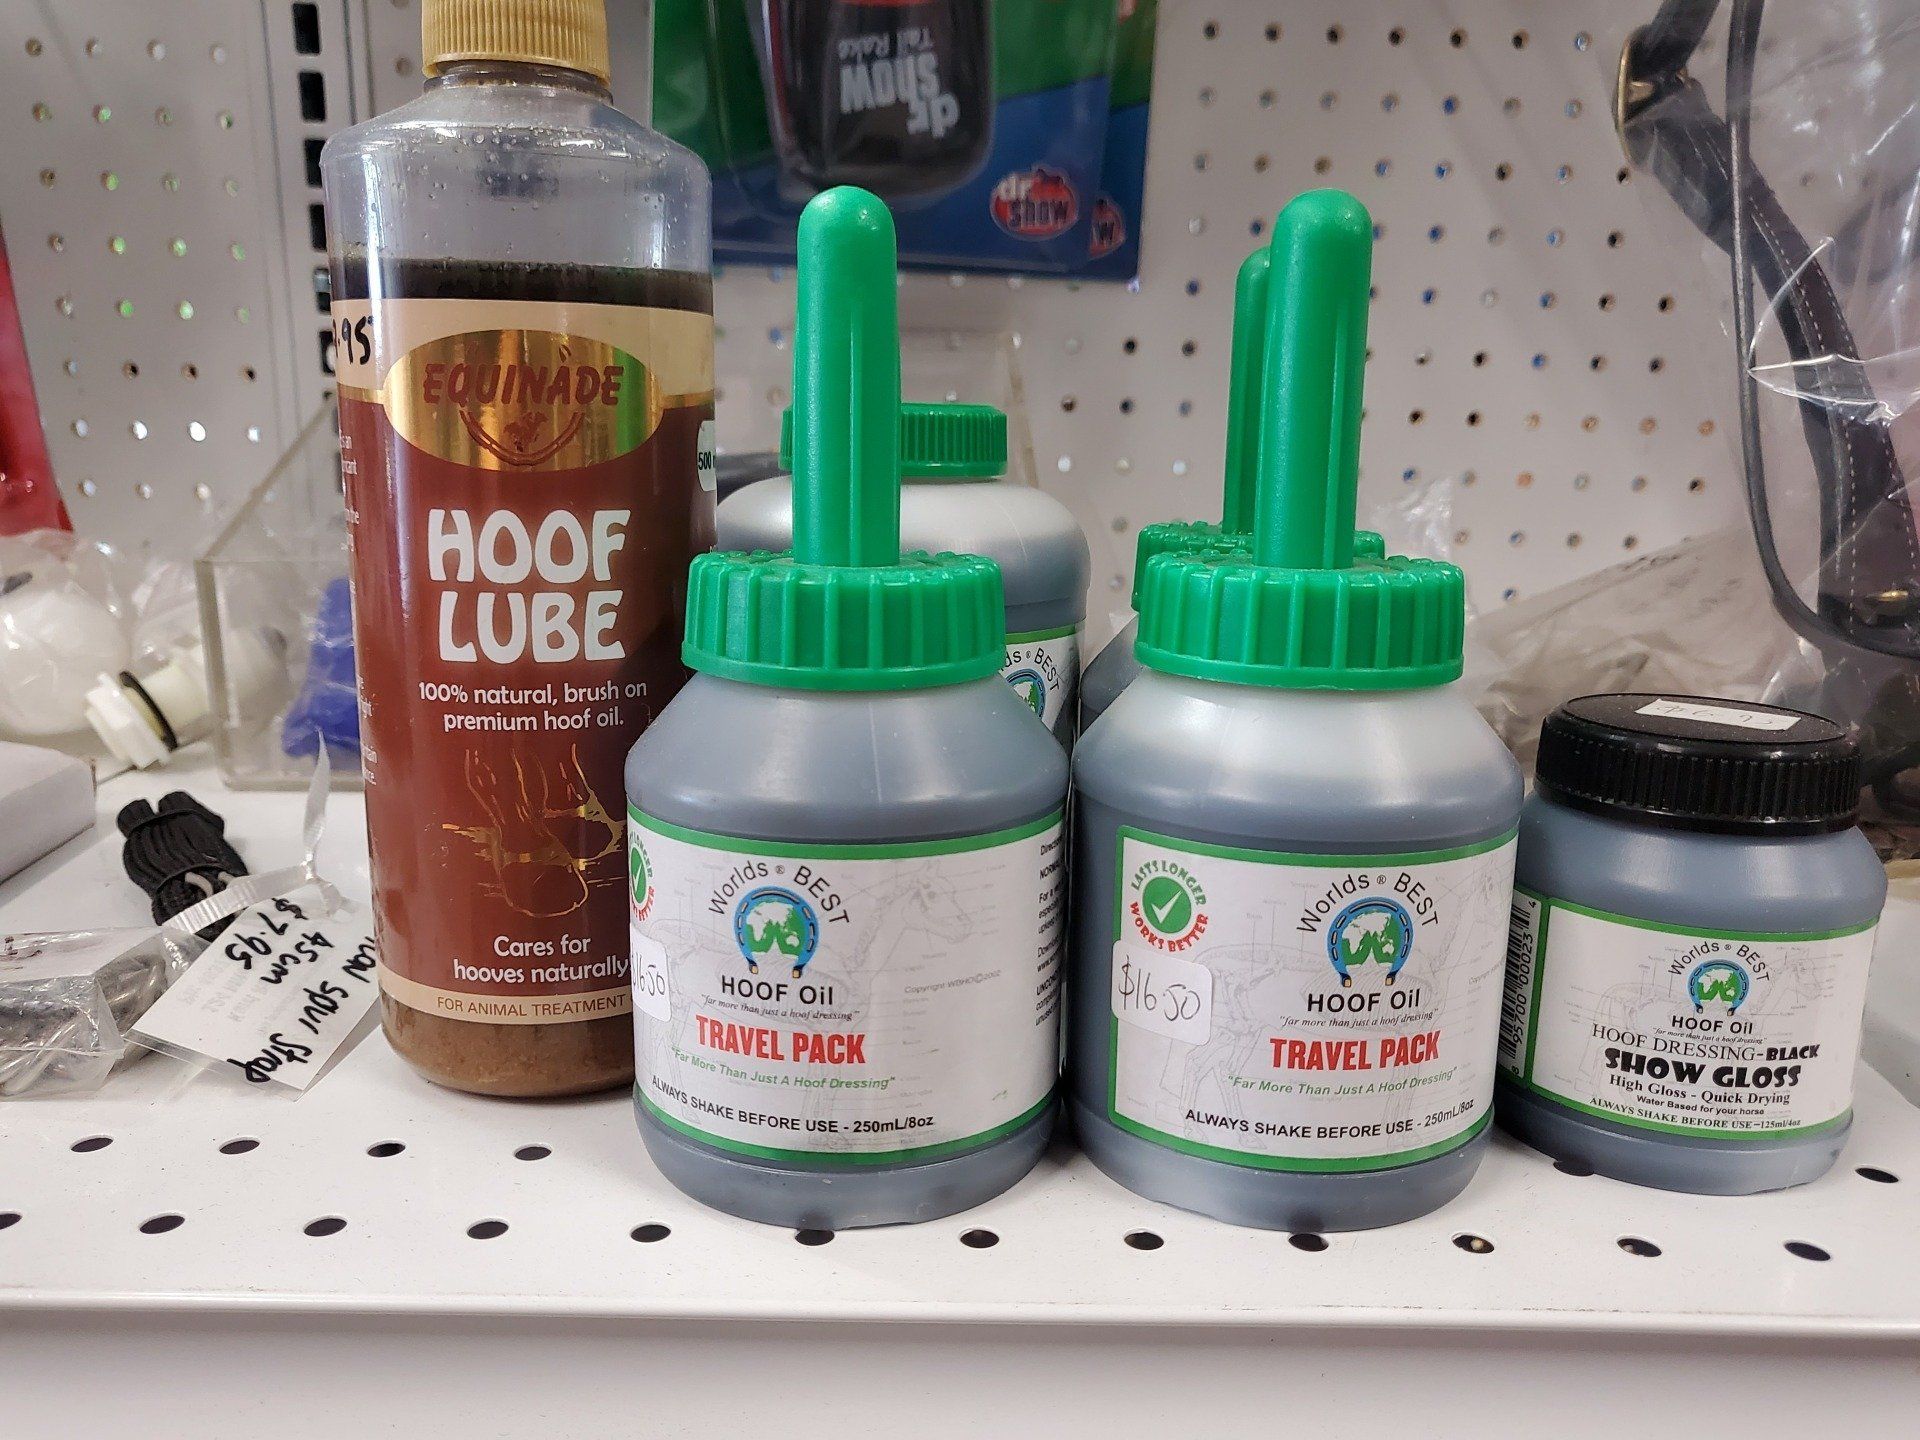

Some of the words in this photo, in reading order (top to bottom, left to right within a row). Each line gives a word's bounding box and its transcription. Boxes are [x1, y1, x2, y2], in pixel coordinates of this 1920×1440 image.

[698, 451, 711, 470] 500
[428, 509, 631, 584] HOOF
[439, 590, 626, 664] LUBE
[1034, 647, 1059, 690] BEST
[419, 682, 468, 703] 100%
[474, 683, 558, 705] natural,
[564, 681, 619, 703] brush
[625, 681, 647, 698] on
[444, 711, 537, 732] premium
[544, 709, 591, 730] hoof
[597, 706, 624, 727] oil.
[709, 860, 768, 915] Worlds
[793, 865, 849, 923] BEST
[1131, 860, 1158, 891] LASTS
[1161, 860, 1207, 906] LONGER
[1296, 874, 1369, 933] Worlds
[1394, 872, 1438, 927] BEST
[1528, 900, 1537, 909] 4
[1130, 901, 1165, 950] WORKS
[1168, 913, 1209, 952] BETTER
[494, 936, 554, 957] Cares
[561, 934, 591, 954] for
[1519, 933, 1533, 985] 00023
[453, 959, 524, 983] hooves
[532, 955, 629, 983] naturally
[1668, 941, 1720, 976] Worlds
[1736, 944, 1770, 982] BEST
[437, 996, 462, 1012] FOR
[468, 998, 527, 1016] ANIMAL
[532, 994, 626, 1016] TREATMENT
[722, 975, 788, 1001] HOOF
[799, 985, 833, 1004] Oil
[1307, 993, 1380, 1012] HOOF
[1390, 988, 1420, 1009] Oil
[718, 1001, 739, 1010] more
[741, 1003, 760, 1014] than
[760, 1007, 778, 1016] just
[790, 1009, 810, 1019] hoof
[1301, 1018, 1326, 1027] more
[1328, 1017, 1350, 1027] than
[1350, 1017, 1369, 1028] just
[1379, 1015, 1401, 1025] hoof
[1512, 993, 1527, 1045] 95700
[1671, 1015, 1724, 1033] HOOF
[1730, 1020, 1753, 1035] Oil
[695, 1014, 785, 1062] TRAVEL
[792, 1032, 867, 1065] PACK
[1270, 1038, 1372, 1071] TRAVEL
[1379, 1030, 1441, 1069] PACK
[1592, 1023, 1648, 1048] HOOF
[1667, 1030, 1685, 1038] more
[1686, 1032, 1701, 1040] than
[691, 1056, 716, 1072] More
[719, 1063, 747, 1080] Than
[750, 1072, 778, 1085] Just
[780, 1075, 791, 1086] A
[793, 1076, 827, 1088] Hoof
[1604, 1047, 1706, 1084] SHOW
[1712, 1065, 1801, 1089] GLOSS
[1259, 1081, 1293, 1094] More
[1298, 1083, 1331, 1096] Than
[1334, 1084, 1363, 1096] Just
[1366, 1083, 1375, 1094] A
[1379, 1079, 1407, 1092] Hoof
[1610, 1075, 1643, 1092] High
[1648, 1083, 1687, 1099] Gloss
[1701, 1091, 1743, 1104] Quick
[1748, 1093, 1790, 1106] Drying
[652, 1074, 688, 1105] ALWAYS
[690, 1097, 734, 1120] SHAKE
[738, 1110, 800, 1131] BEFORE
[806, 1119, 838, 1133] USE
[853, 1115, 934, 1133] 250mL/8oz
[1185, 1109, 1250, 1132] ALWAYS
[1254, 1122, 1311, 1139] SHAKE
[1317, 1123, 1381, 1139] BEFORE
[1386, 1119, 1414, 1135] USE
[1424, 1098, 1475, 1127] 250mL/8oz
[1589, 1097, 1635, 1115] ALWAYS
[1637, 1108, 1678, 1123] SHAKE
[1681, 1116, 1728, 1129] BEFORE
[1732, 1121, 1753, 1129] USE
[1637, 1095, 1663, 1107] Water
[1667, 1101, 1698, 1112] Based
[1700, 1105, 1714, 1113] for
[1715, 1107, 1737, 1116] your
